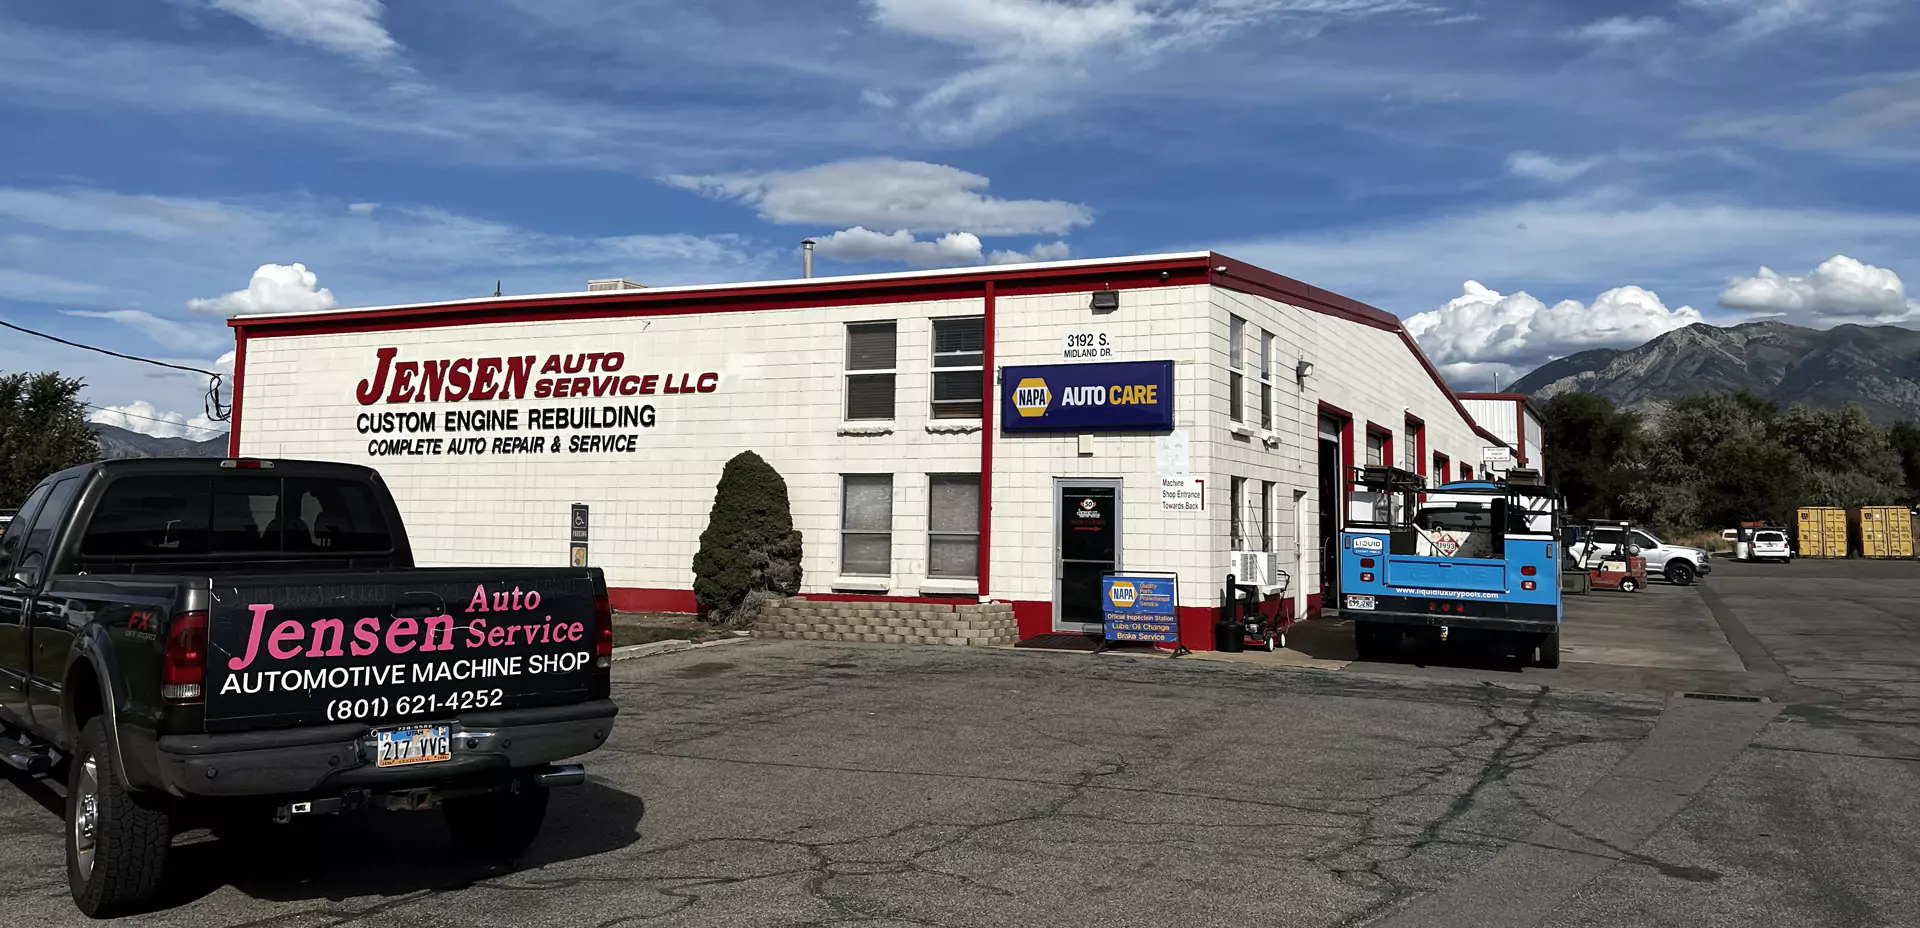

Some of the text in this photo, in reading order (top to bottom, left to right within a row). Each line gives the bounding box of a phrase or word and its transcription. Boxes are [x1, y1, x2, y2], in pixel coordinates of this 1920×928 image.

[1067, 332, 1110, 347] 3192 S.
[1063, 347, 1113, 358] MIDLAND DR.
[356, 347, 625, 406] JENSEN AUTO
[534, 372, 719, 398] SERVICE LLC
[1018, 384, 1158, 407] NAPA AUTO CARE
[356, 404, 656, 434] CUSTOM ENGINE REBUILDING
[367, 434, 639, 457] COMPLETE AUTO REPAIR & SERVICE
[1162, 479, 1184, 487] Machine
[1162, 490, 1201, 499] Shop Entrance
[1162, 501, 1199, 510] Towards Back
[1439, 541, 1455, 550] 1993
[465, 583, 541, 613] Auto
[1113, 588, 1134, 600] NAPA
[1395, 587, 1499, 599] www.liquidluxurypools.com
[228, 603, 455, 671] Jensen
[465, 615, 584, 648] Service
[220, 651, 590, 695] AUTOMOTIVE MACHINE SHOP
[326, 688, 504, 721] (801) 621-4252
[406, 729, 424, 737] UTAH
[383, 737, 447, 760] 217 VVG
